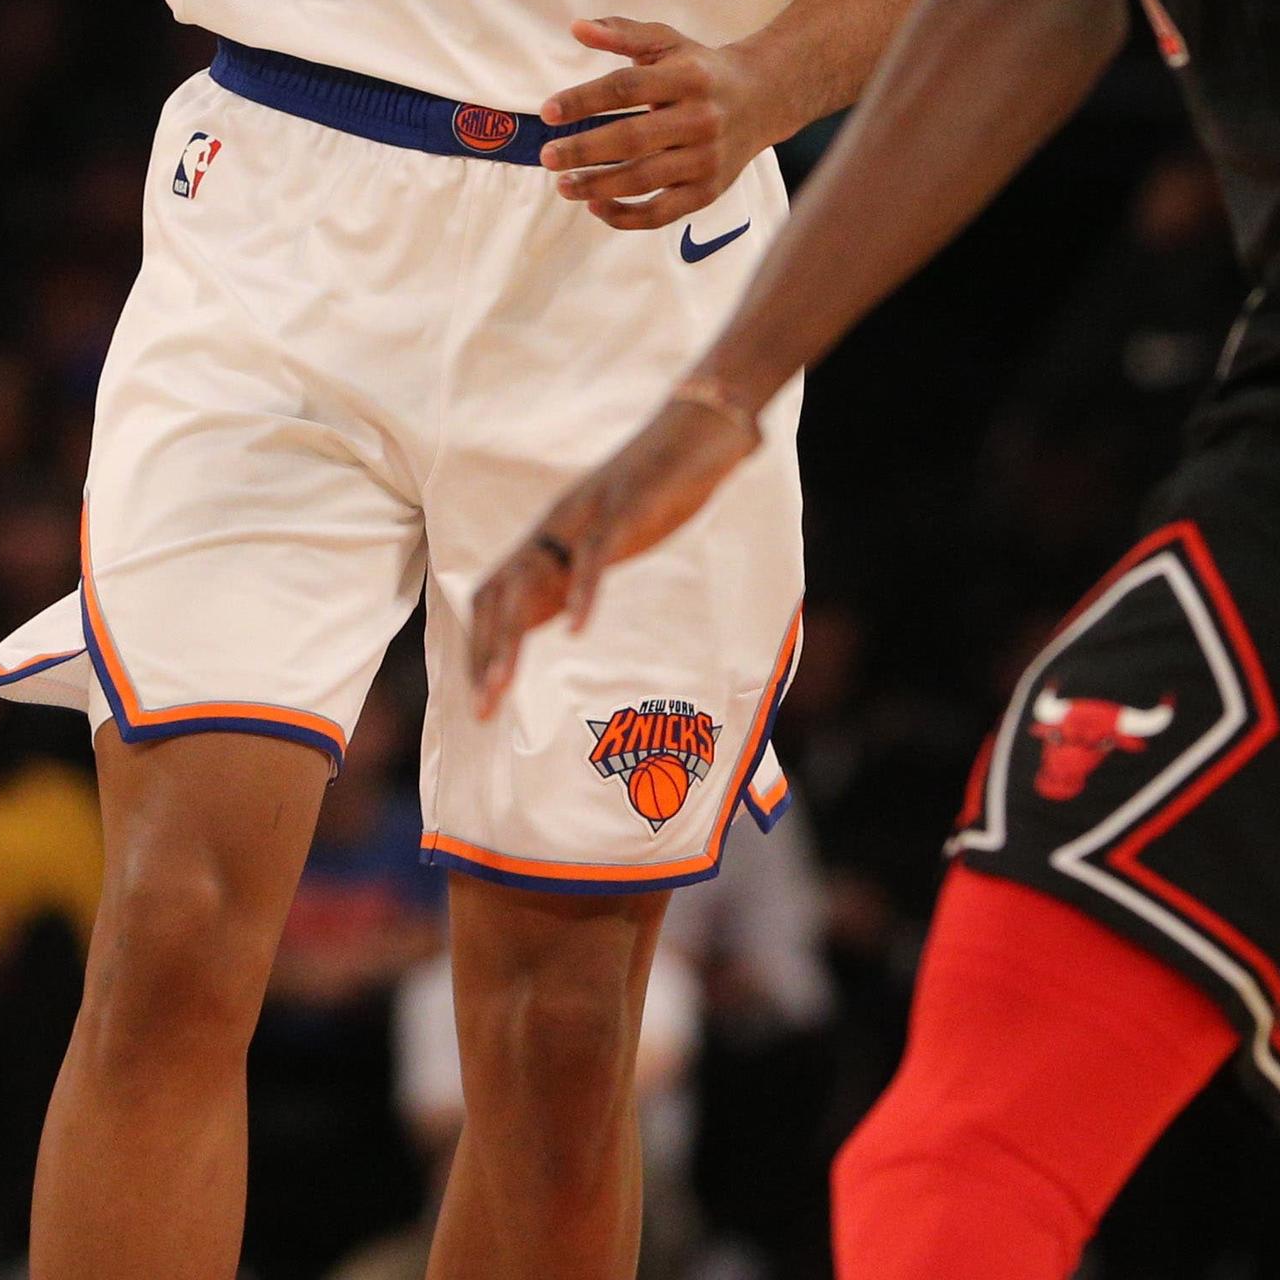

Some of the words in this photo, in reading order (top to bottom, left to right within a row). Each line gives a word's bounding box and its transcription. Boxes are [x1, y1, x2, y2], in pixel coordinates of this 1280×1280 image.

[638, 699, 668, 714] NEW
[668, 699, 696, 716] YORK
[589, 706, 715, 770] KNICKS
